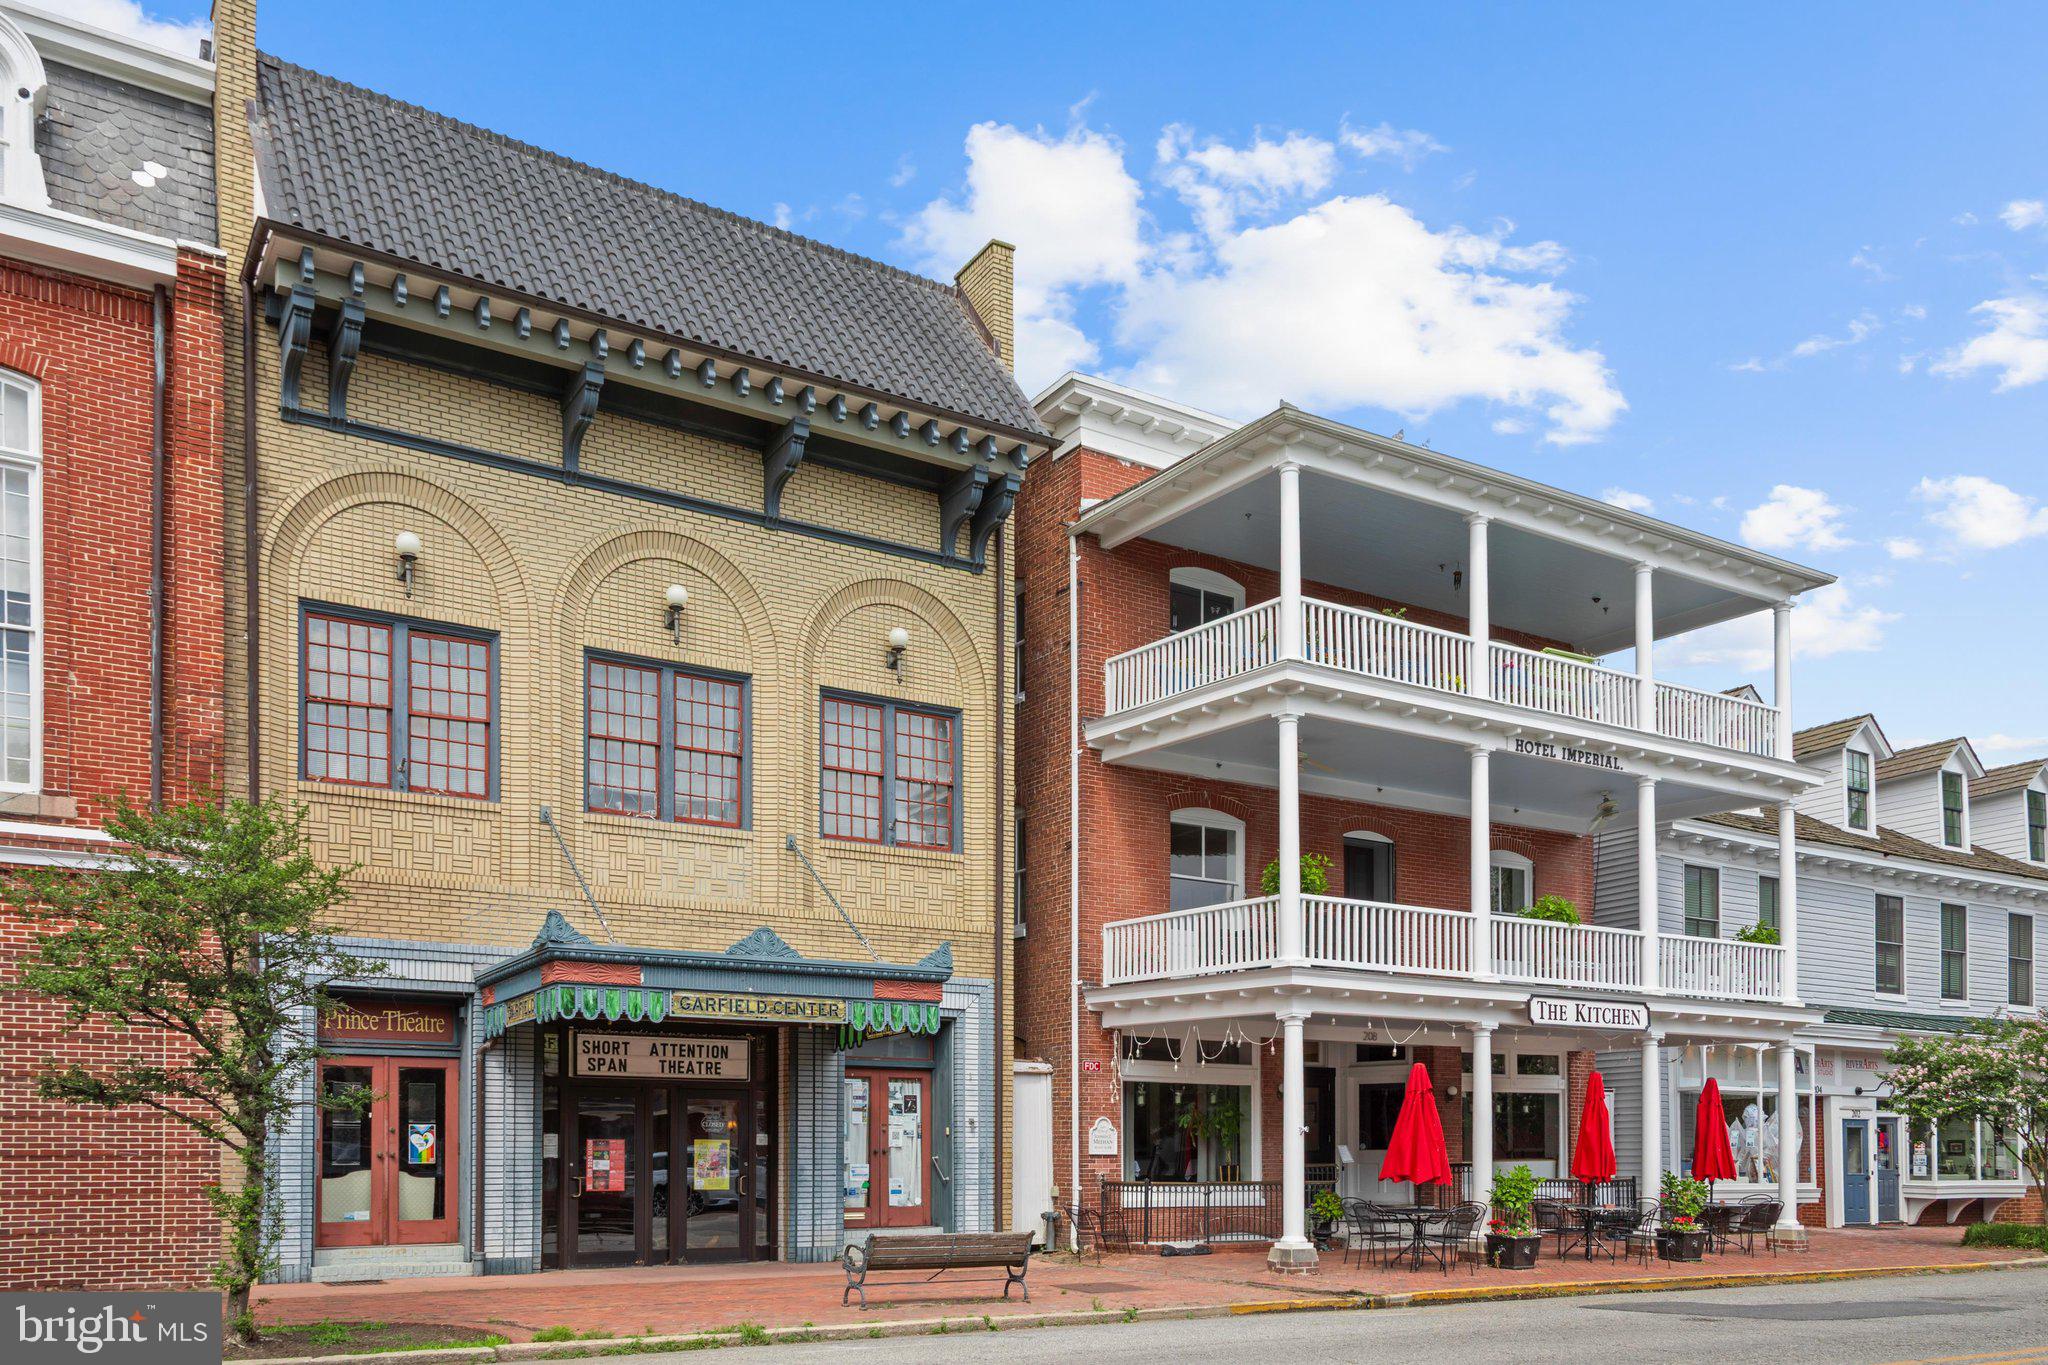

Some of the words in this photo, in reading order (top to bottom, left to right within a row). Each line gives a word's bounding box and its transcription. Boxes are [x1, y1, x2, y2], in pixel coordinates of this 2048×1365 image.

[1515, 738, 1556, 758] HOTEL
[679, 996, 767, 1014] GARFIELD
[773, 1001, 839, 1017] CENTER
[1537, 1000, 1568, 1021] THE
[1575, 1003, 1641, 1026] KITCHEN
[324, 1008, 379, 1031] Prince
[383, 1010, 445, 1033] Theatre
[1363, 1031, 1378, 1041] 208
[582, 1040, 630, 1056] SHORT
[649, 1043, 729, 1059] ATTENTION
[587, 1057, 628, 1073] SPAN
[659, 1059, 722, 1075] THEATRE
[1084, 1061, 1100, 1071] FDC
